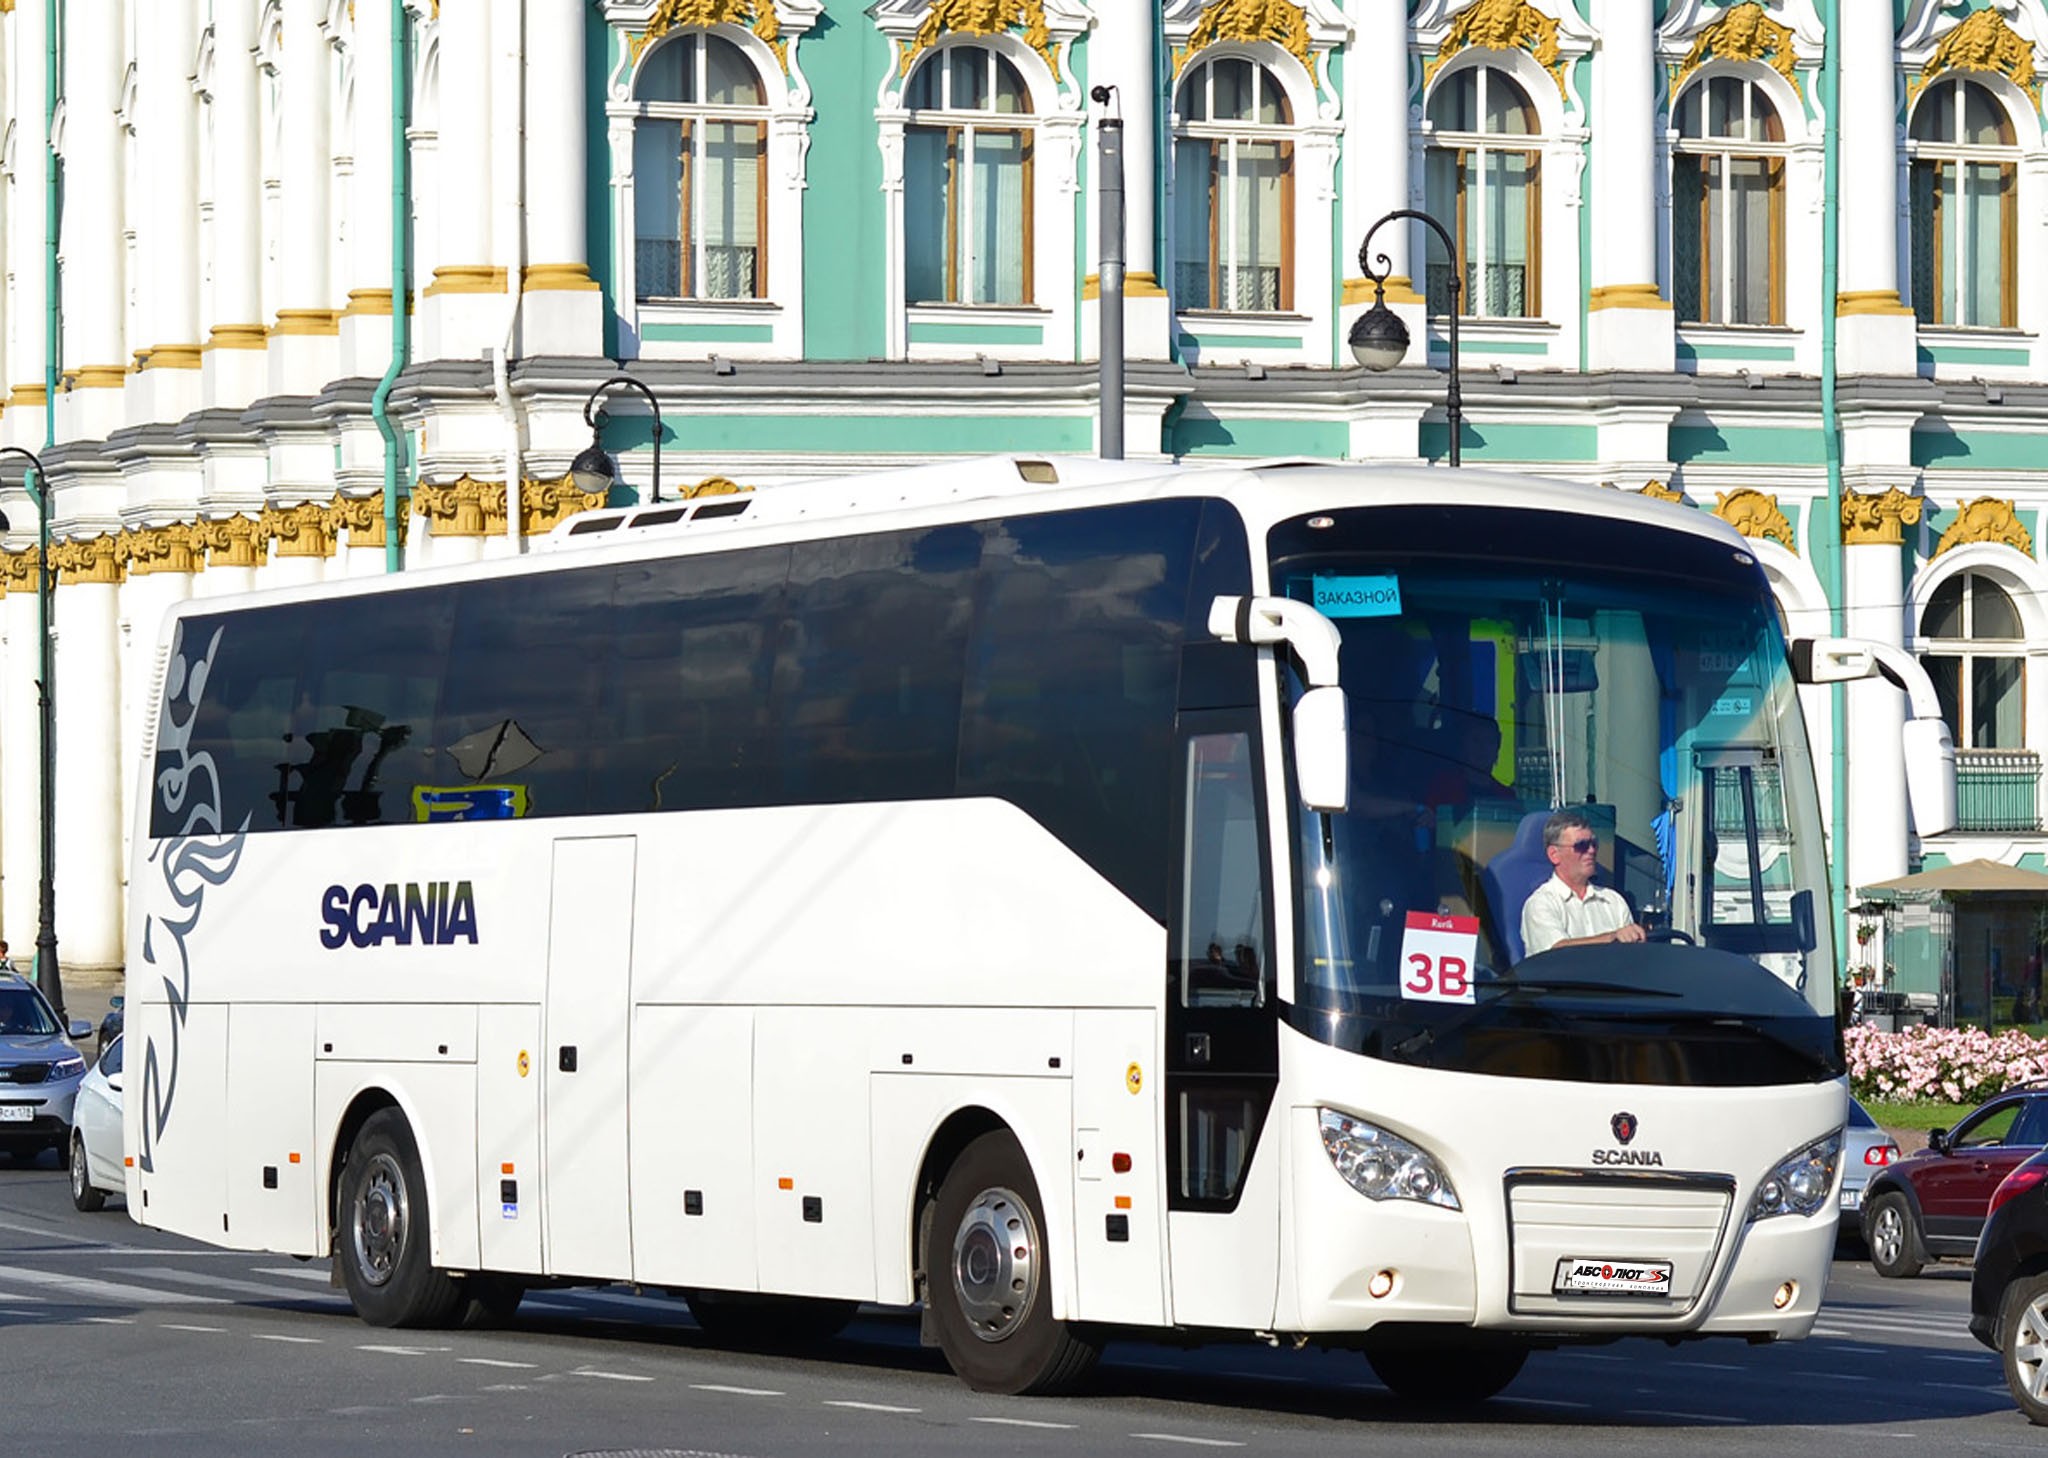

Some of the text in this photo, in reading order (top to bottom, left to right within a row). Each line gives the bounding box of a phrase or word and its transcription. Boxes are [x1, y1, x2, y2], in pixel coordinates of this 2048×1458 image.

[1317, 587, 1397, 605] ЗАКАЗНОЙ
[319, 880, 479, 950] SCANIA
[1406, 953, 1467, 996] 3B
[1592, 1149, 1663, 1166] SCANIA
